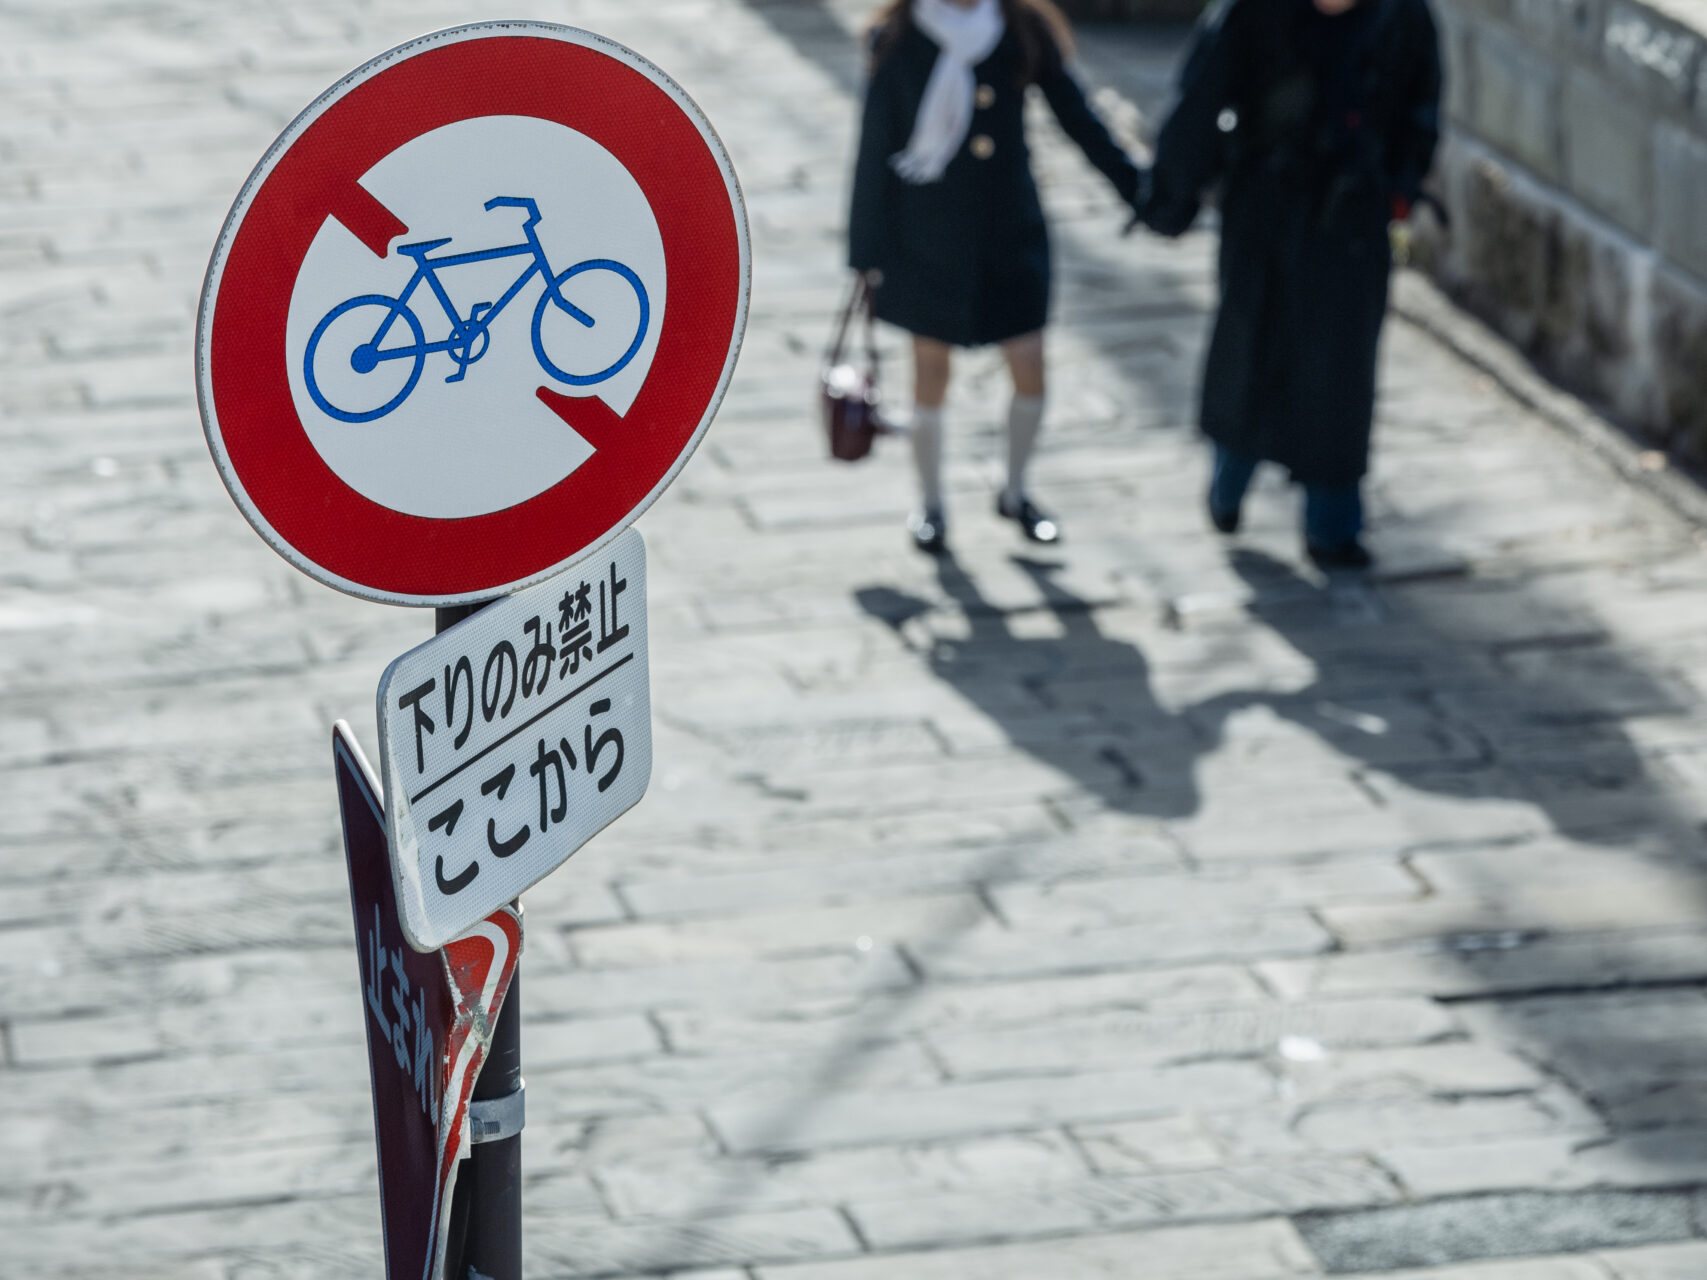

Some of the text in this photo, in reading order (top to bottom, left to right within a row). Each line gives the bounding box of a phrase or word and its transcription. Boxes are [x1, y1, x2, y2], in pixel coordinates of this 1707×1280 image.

[398, 561, 630, 774] 下りのみ禁止
[428, 697, 625, 896] ここから
[367, 903, 438, 1126] 止まれ
